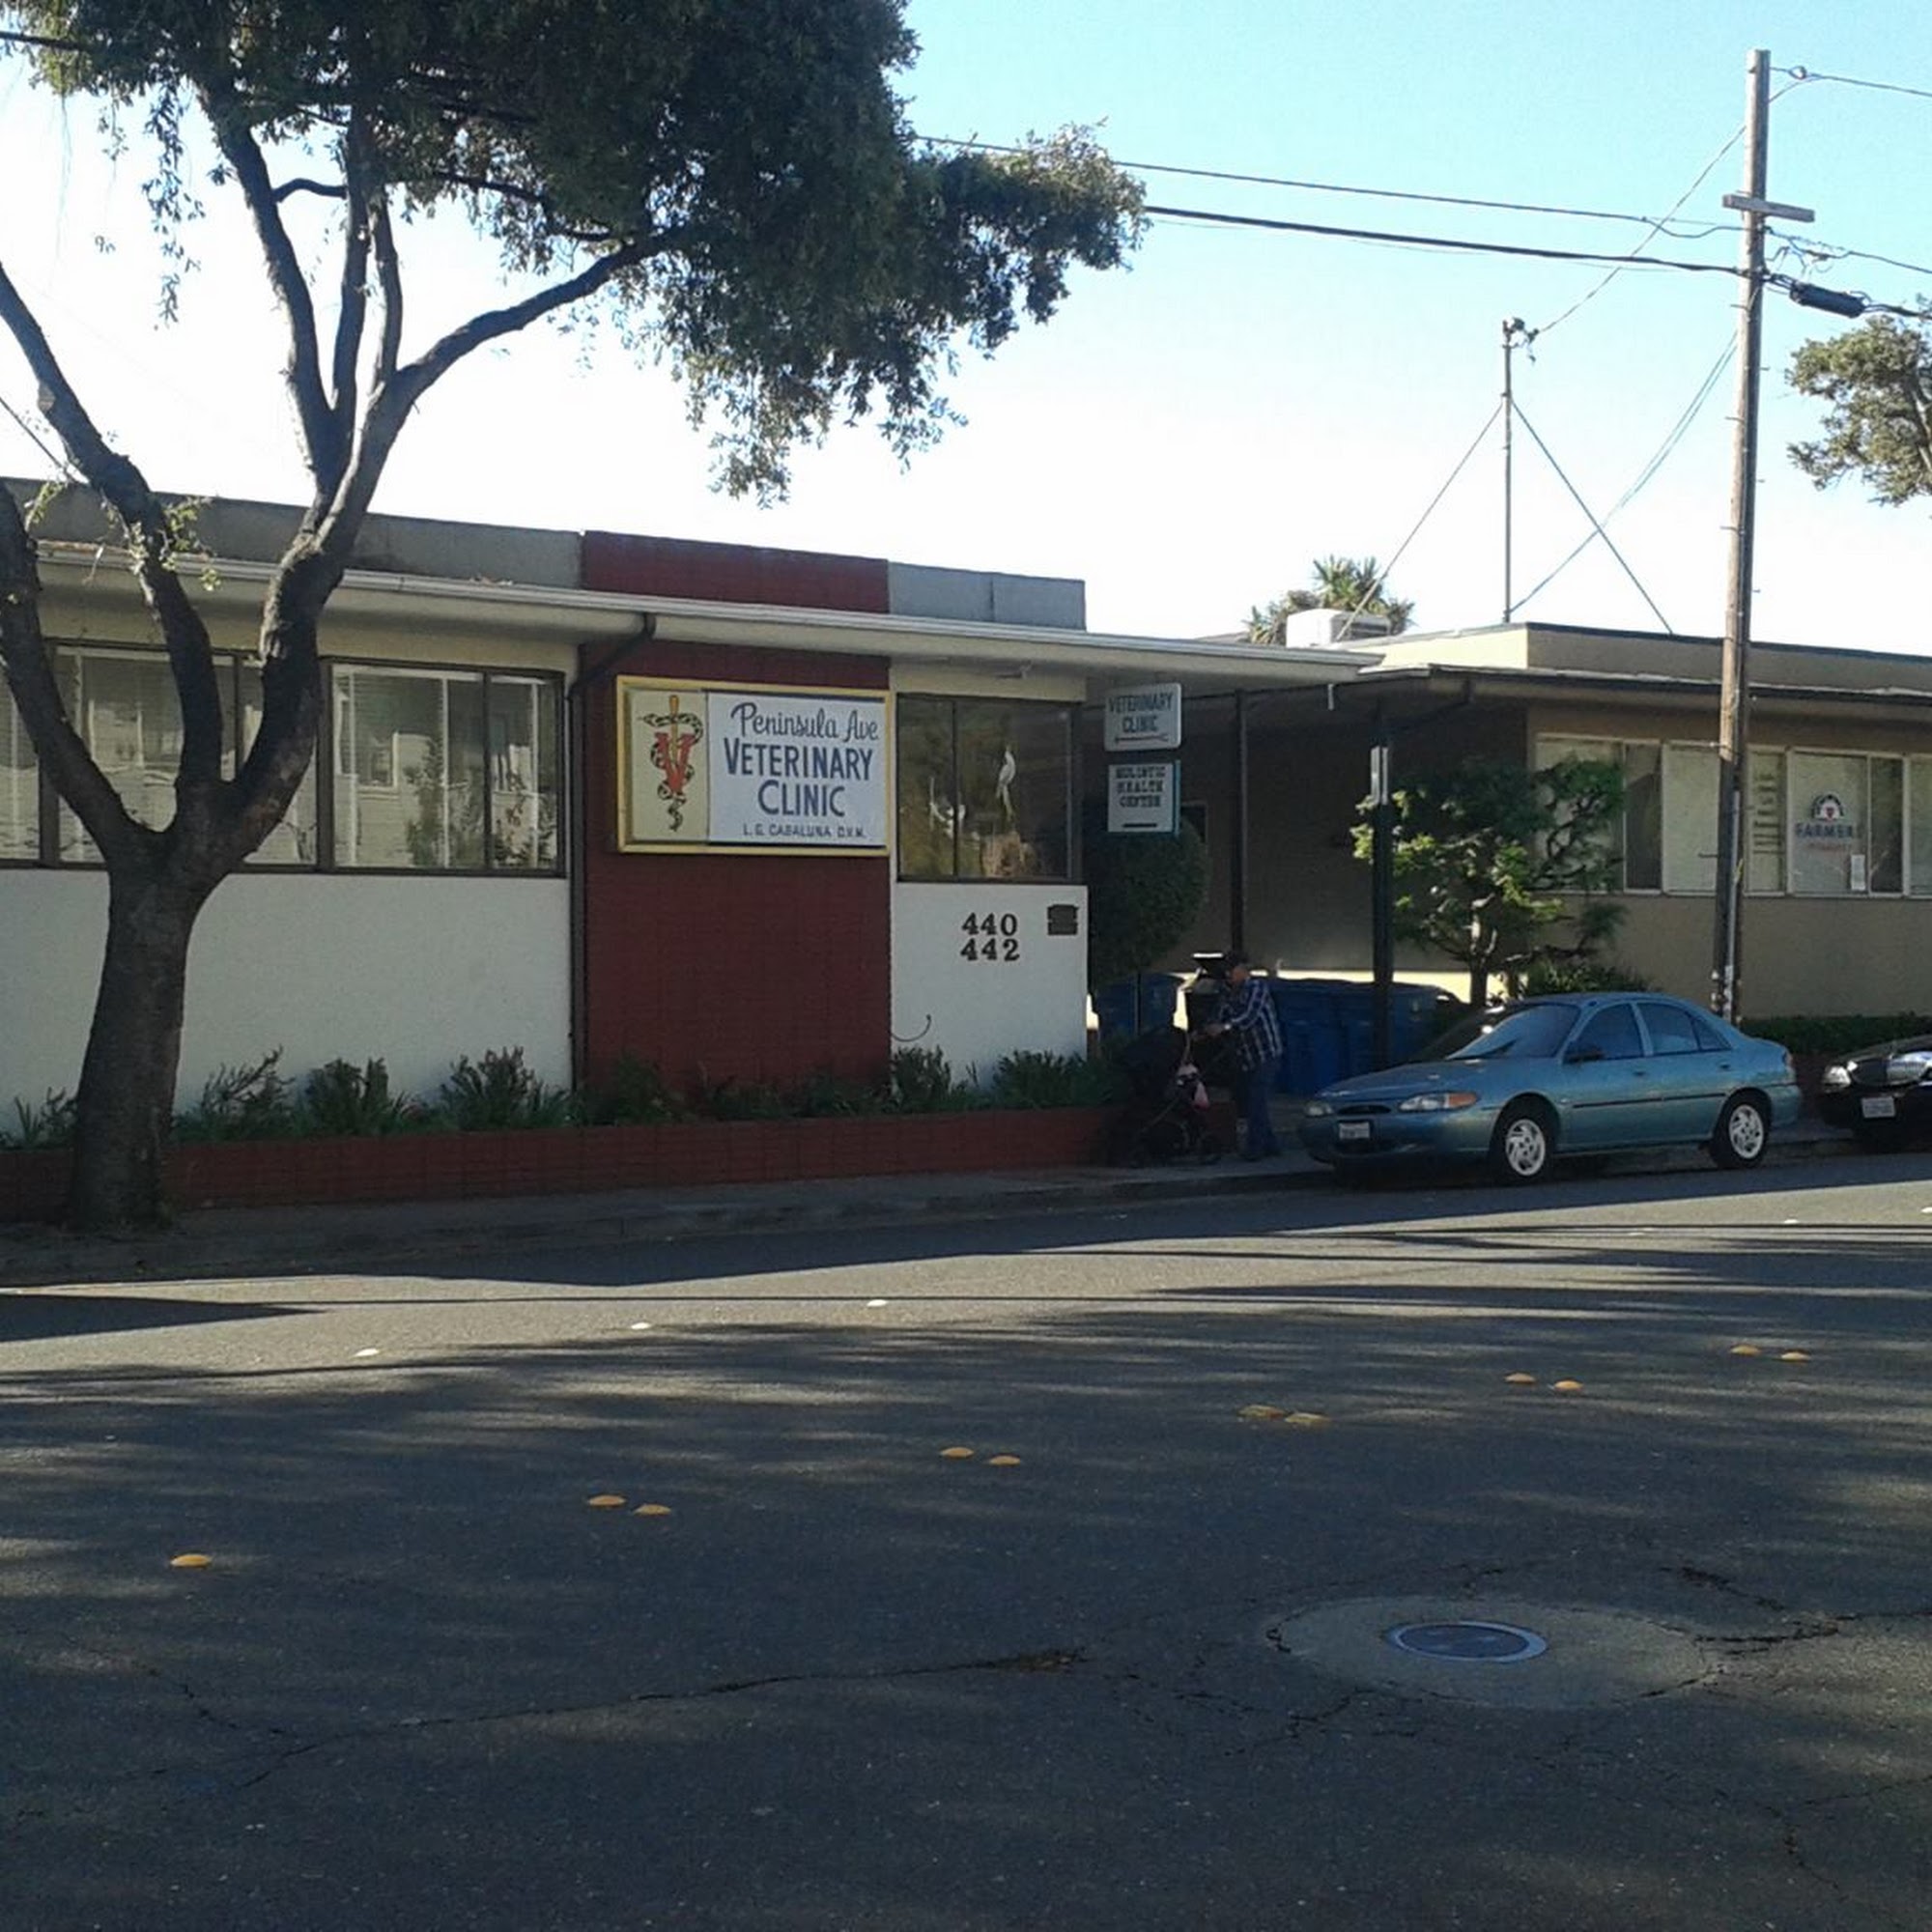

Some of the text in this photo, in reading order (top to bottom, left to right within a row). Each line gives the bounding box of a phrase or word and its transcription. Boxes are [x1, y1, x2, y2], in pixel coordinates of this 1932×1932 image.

[1108, 692, 1173, 712] VETERINARY
[730, 702, 878, 742] Peninsula Ave
[1122, 715, 1158, 733] CLINIC
[724, 737, 873, 781] VETERINARY
[758, 779, 845, 817] CLINIC
[962, 913, 1017, 936] 440
[960, 938, 1020, 961] 442
